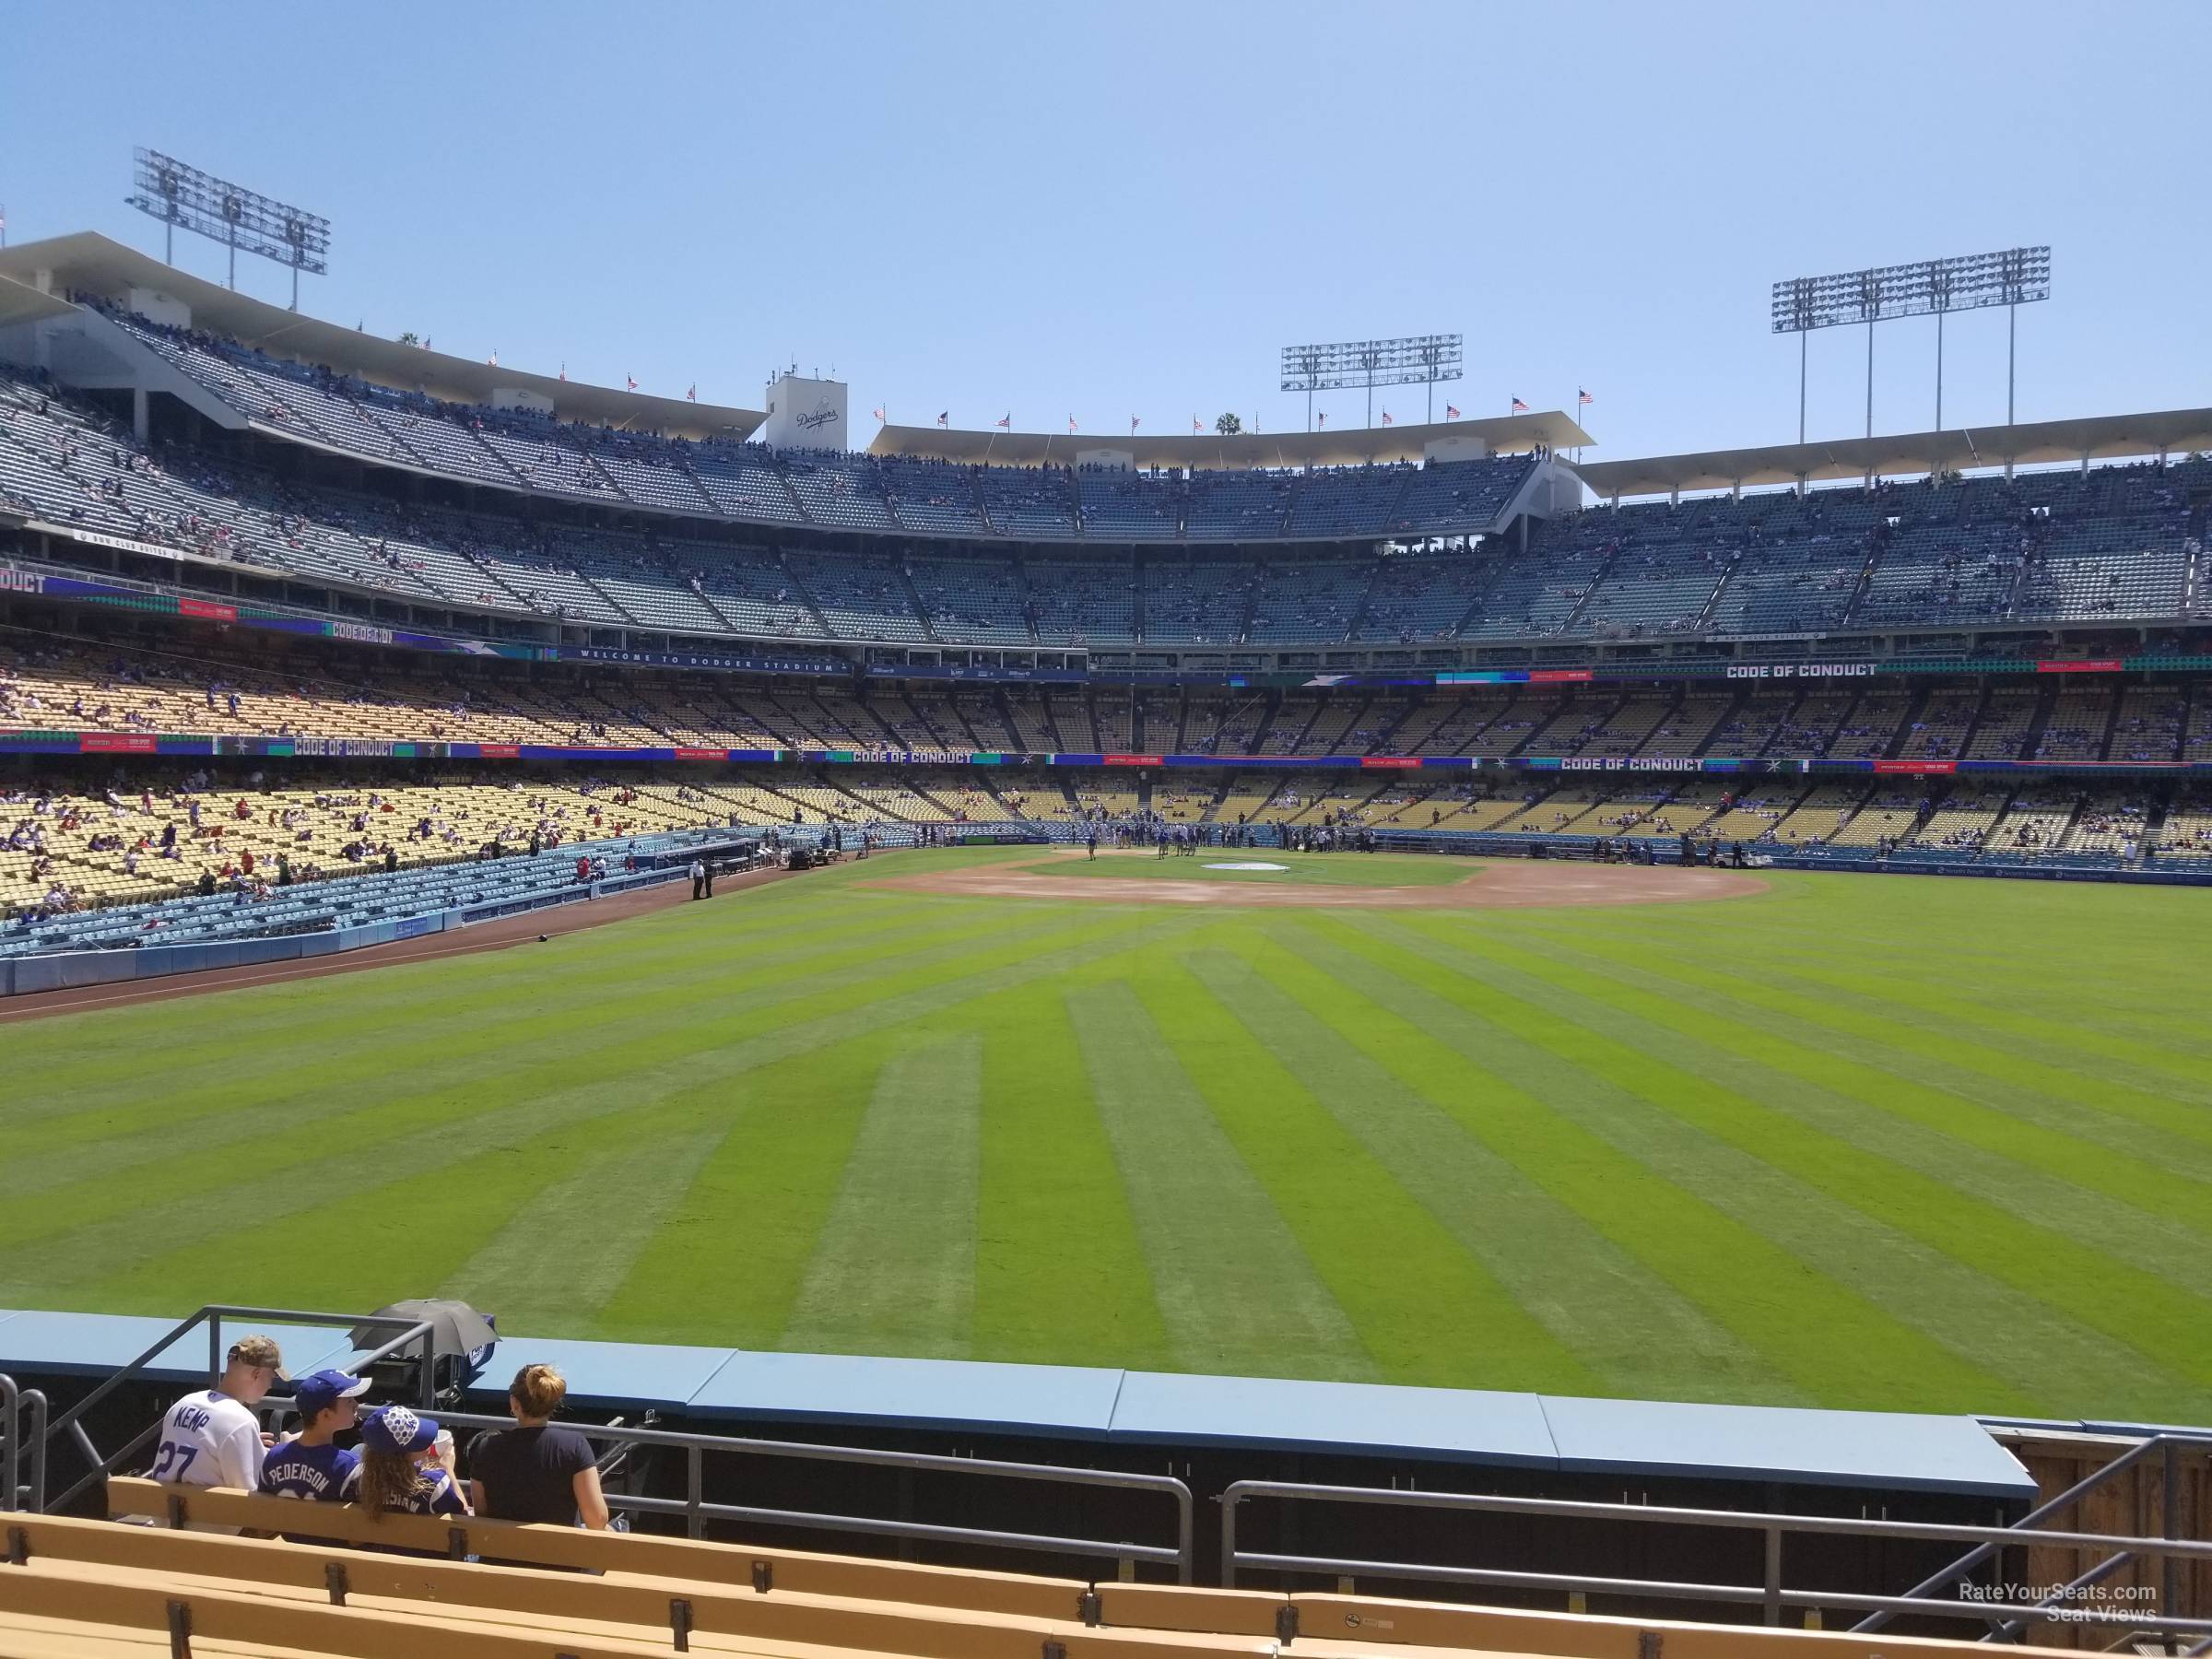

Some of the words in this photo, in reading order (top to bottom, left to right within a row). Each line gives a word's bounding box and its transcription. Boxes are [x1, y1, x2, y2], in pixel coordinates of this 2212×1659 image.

[796, 410, 838, 429] Dodgers
[116, 539, 135, 549] CLUB
[140, 545, 167, 556] SUITES
[582, 650, 650, 661] WELCOME
[691, 658, 751, 668] DODGER
[764, 662, 832, 672] STADIUM
[1727, 666, 1769, 678] CODE
[1773, 665, 1794, 677] OF
[1799, 664, 1877, 677] CONDUCT
[295, 738, 325, 756] CODE
[328, 739, 343, 756] OF
[346, 740, 394, 757] CONDUCT
[853, 751, 887, 763] CODE
[891, 752, 907, 763] OF
[912, 752, 972, 764] CONDUCT
[1561, 759, 1601, 771] CODE
[1606, 759, 1625, 771] OF
[1630, 759, 1703, 771] CONDUCT
[173, 1406, 210, 1432] KEMP
[153, 1440, 198, 1483] 27
[269, 1463, 330, 1492] PEDERSON
